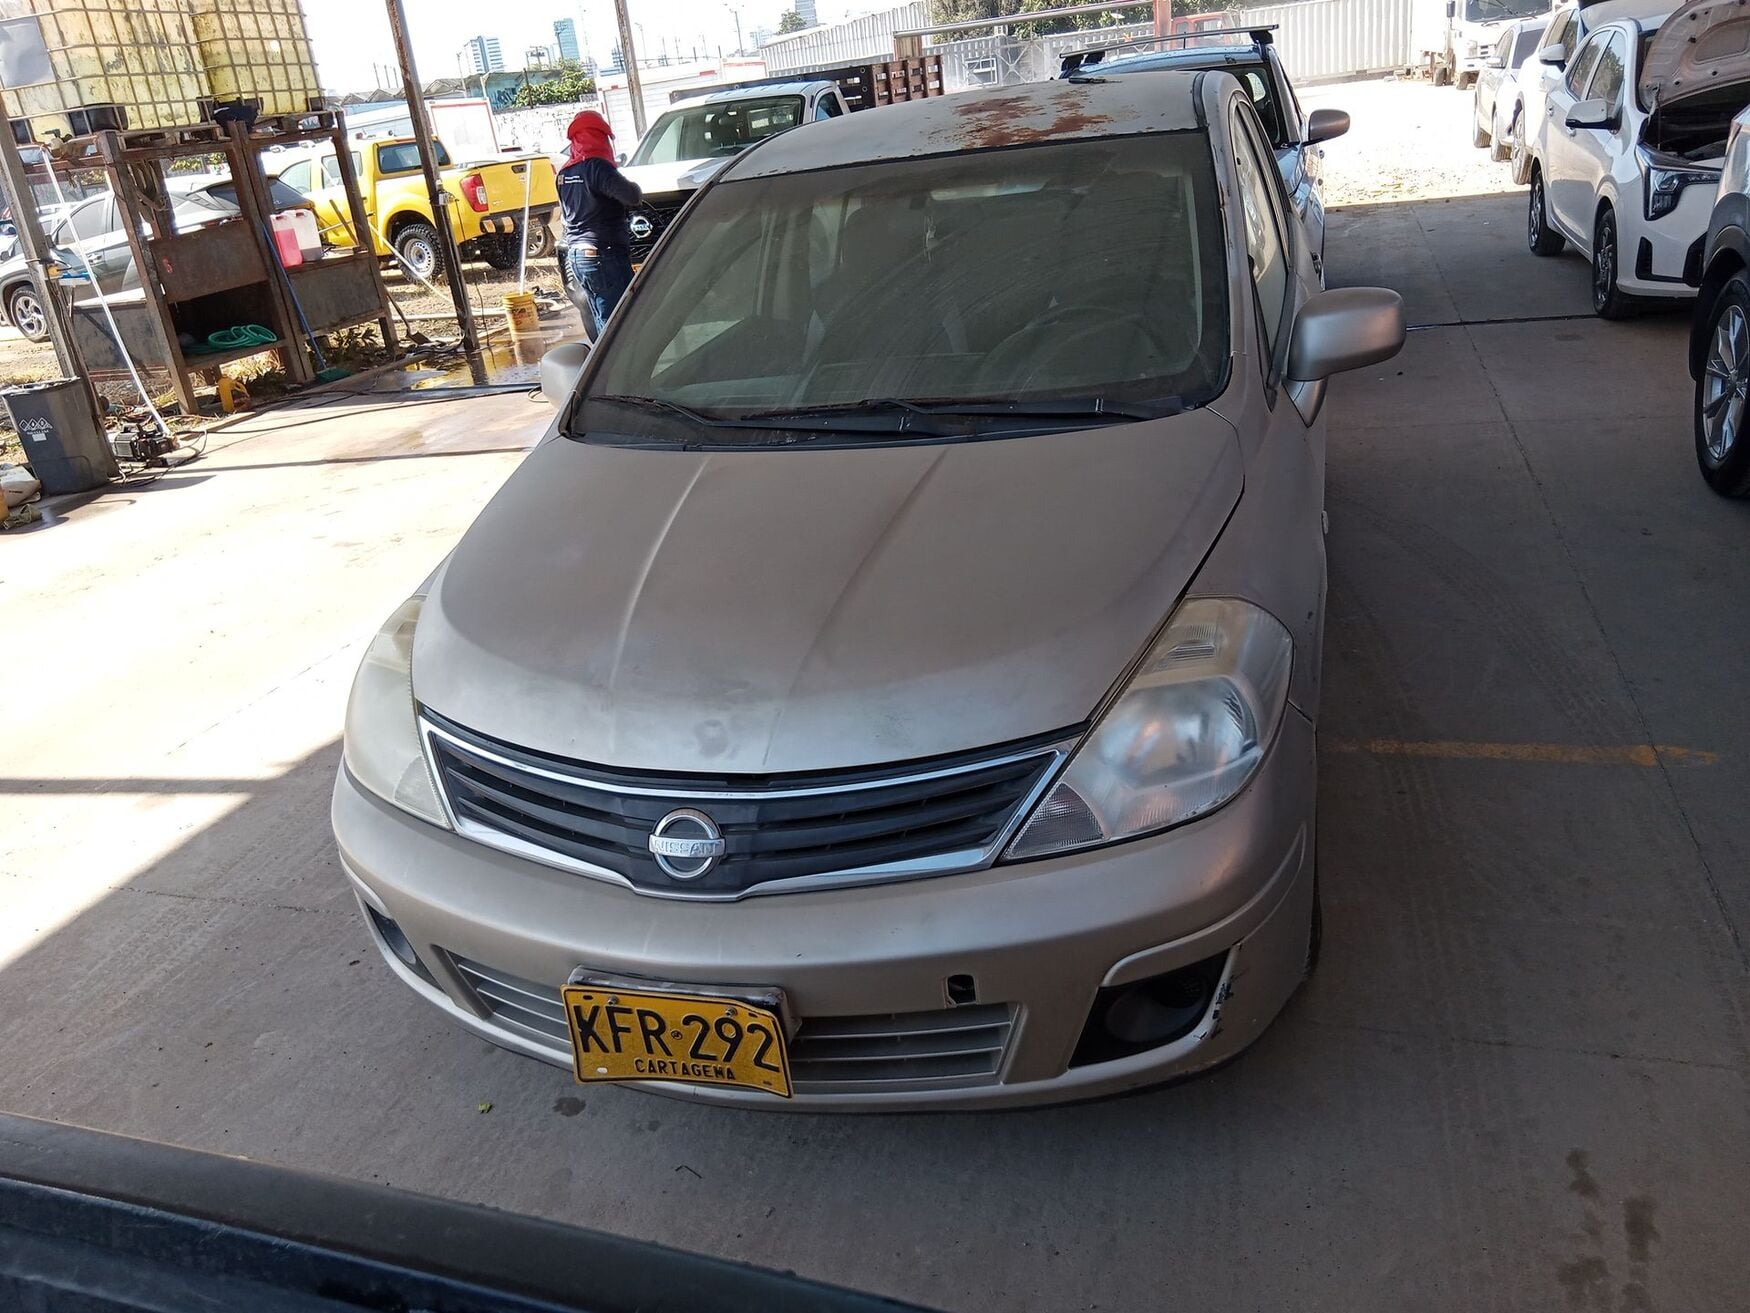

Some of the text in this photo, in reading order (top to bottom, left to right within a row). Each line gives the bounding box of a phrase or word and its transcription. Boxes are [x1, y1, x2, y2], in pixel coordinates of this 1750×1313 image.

[654, 840, 717, 856] NISSAN
[573, 1004, 780, 1073] KFR 292
